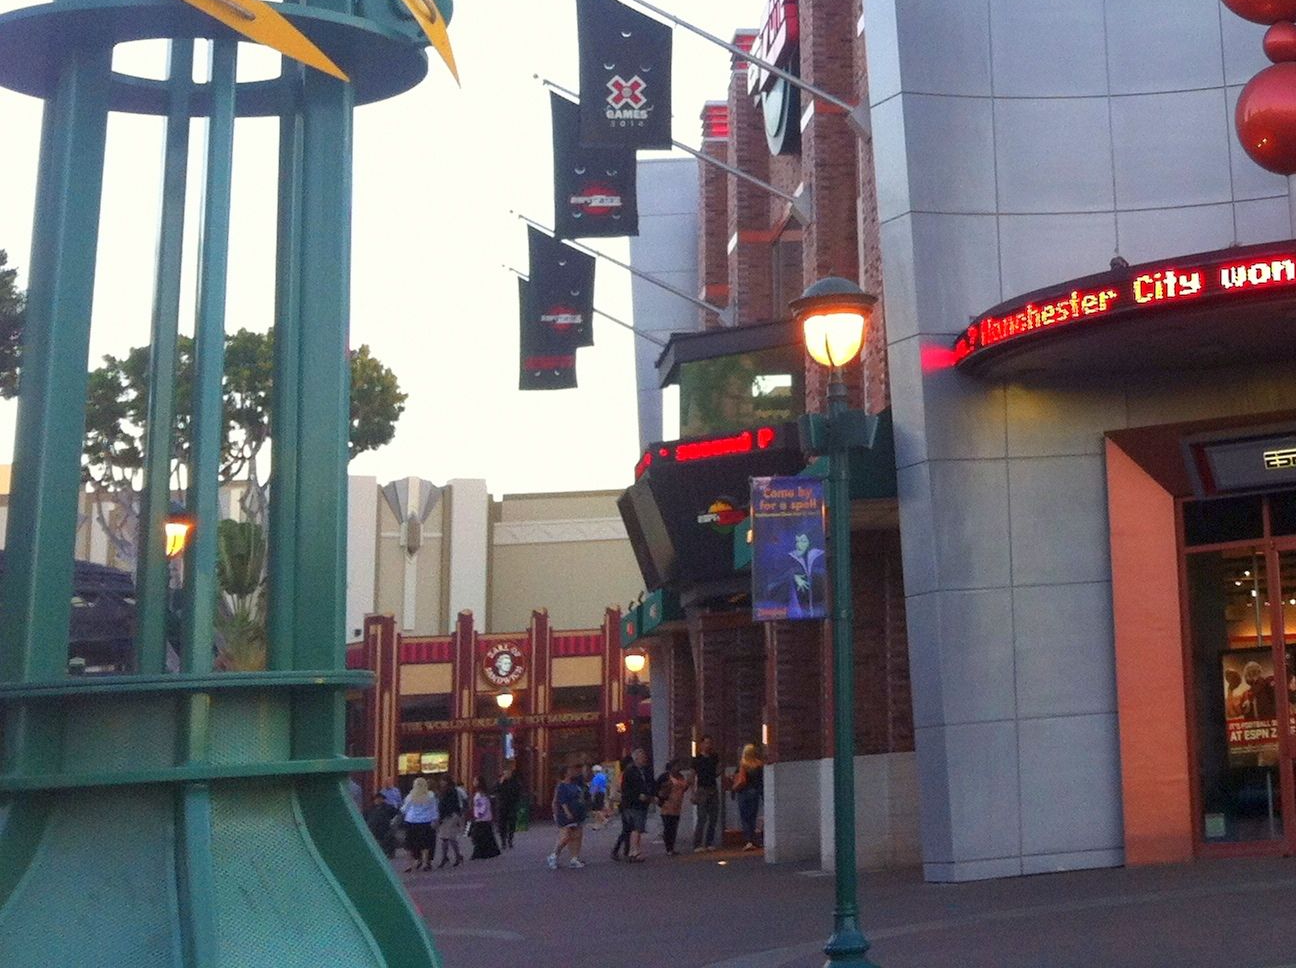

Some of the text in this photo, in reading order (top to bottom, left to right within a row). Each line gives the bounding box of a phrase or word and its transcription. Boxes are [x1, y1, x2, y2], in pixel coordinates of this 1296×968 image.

[606, 109, 648, 120] GAMES
[980, 288, 1118, 346] Manchester
[1132, 269, 1201, 304] City
[1220, 257, 1296, 290] won
[1230, 731, 1242, 742] AT
[1244, 729, 1269, 740] ESPN
